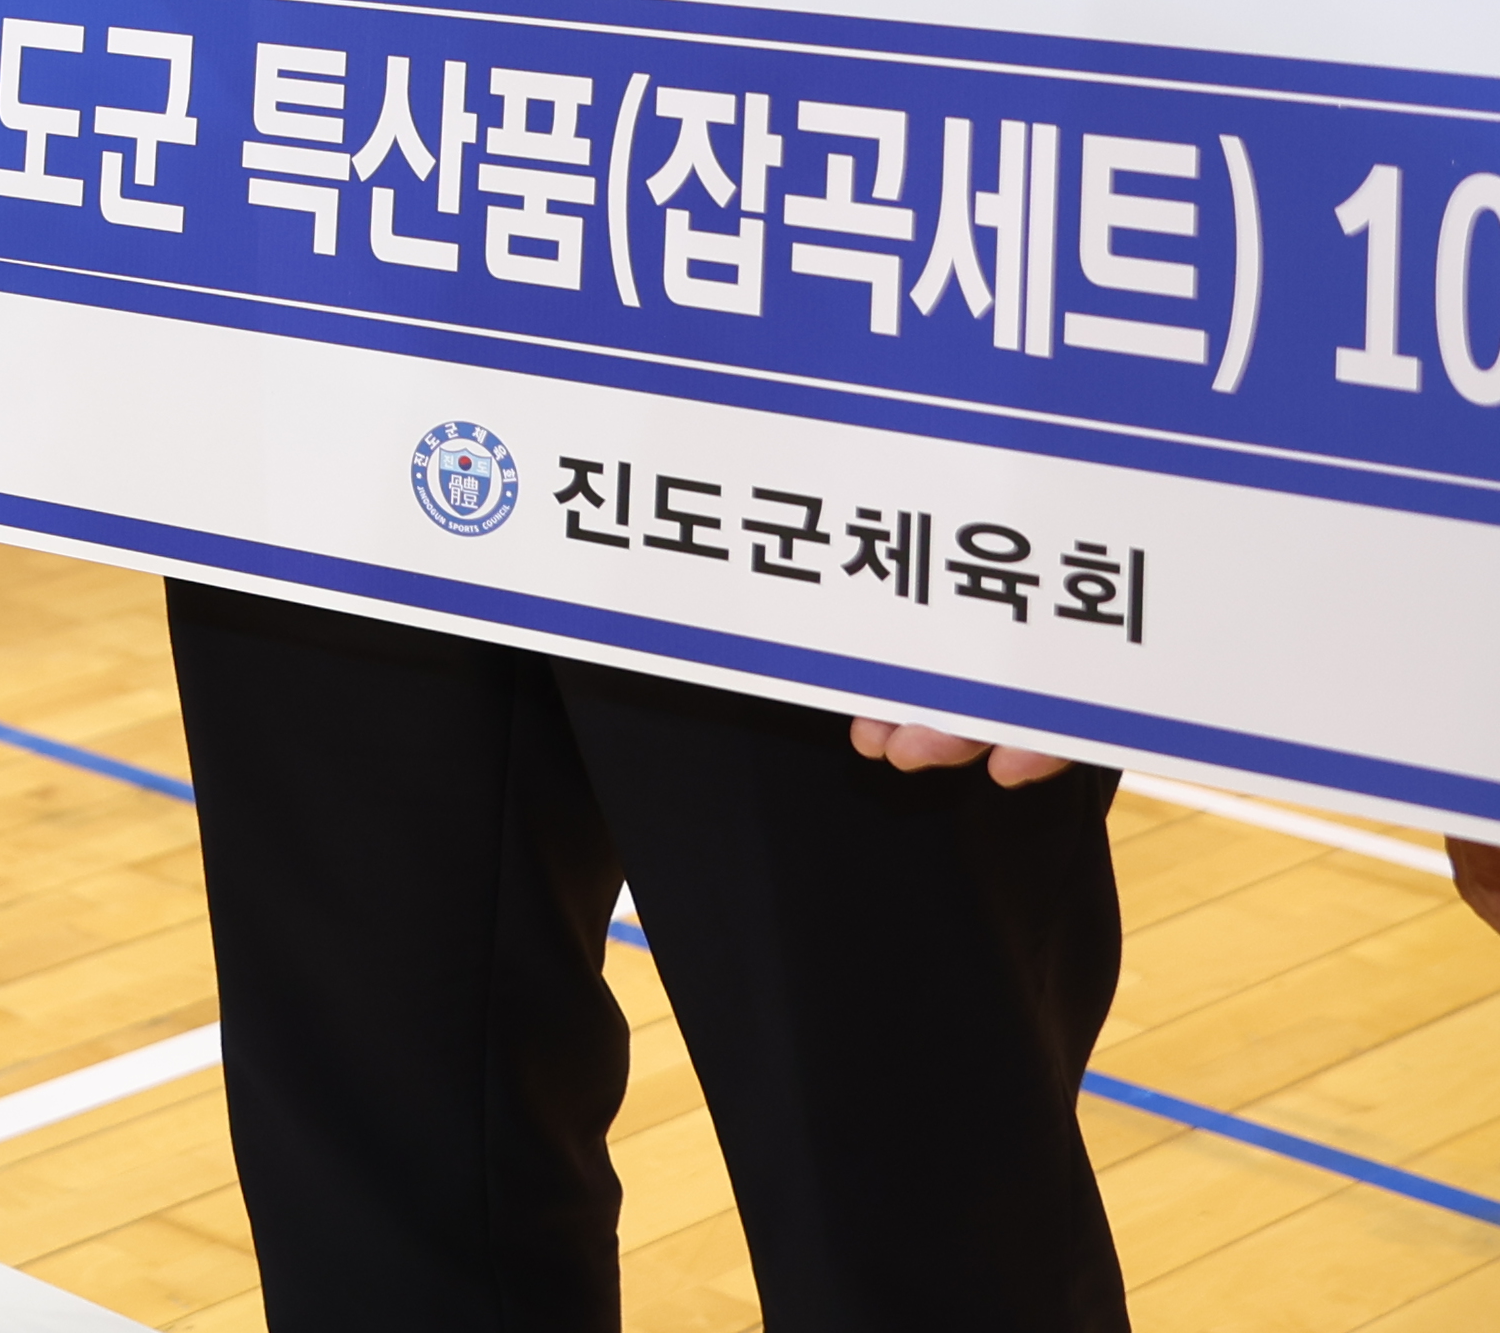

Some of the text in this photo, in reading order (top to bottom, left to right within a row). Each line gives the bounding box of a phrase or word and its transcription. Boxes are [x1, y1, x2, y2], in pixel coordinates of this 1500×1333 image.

[240, 41, 1264, 396] 특산품(잡곡세트)
[448, 521, 480, 533] SPORTS
[482, 504, 511, 530] COUNCIL
[553, 452, 1148, 646] 진도군체육회
